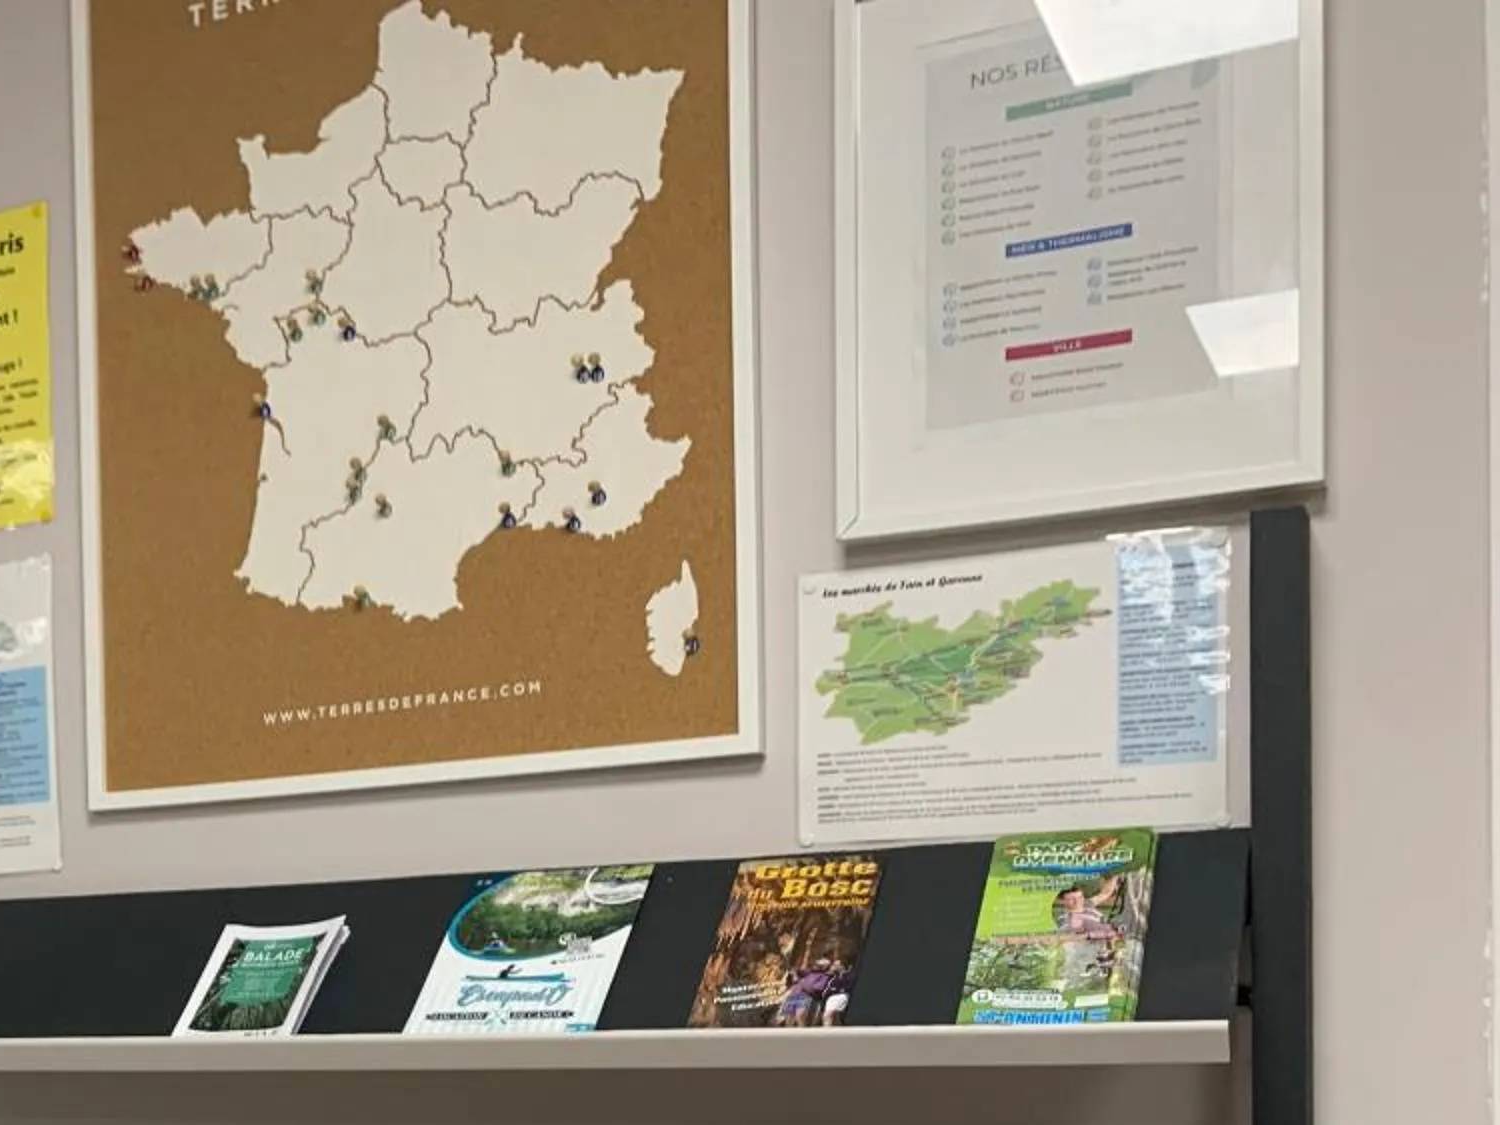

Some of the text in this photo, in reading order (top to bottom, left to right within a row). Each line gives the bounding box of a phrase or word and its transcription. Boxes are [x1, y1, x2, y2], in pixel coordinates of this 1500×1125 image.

[189, 0, 280, 27] TER
[971, 64, 1018, 89] NOS
[263, 680, 542, 726] WWW.TERRESDEFRANCE.COM
[755, 860, 879, 881] Grotte
[780, 879, 874, 899] Bosc
[243, 948, 304, 962] BALADE
